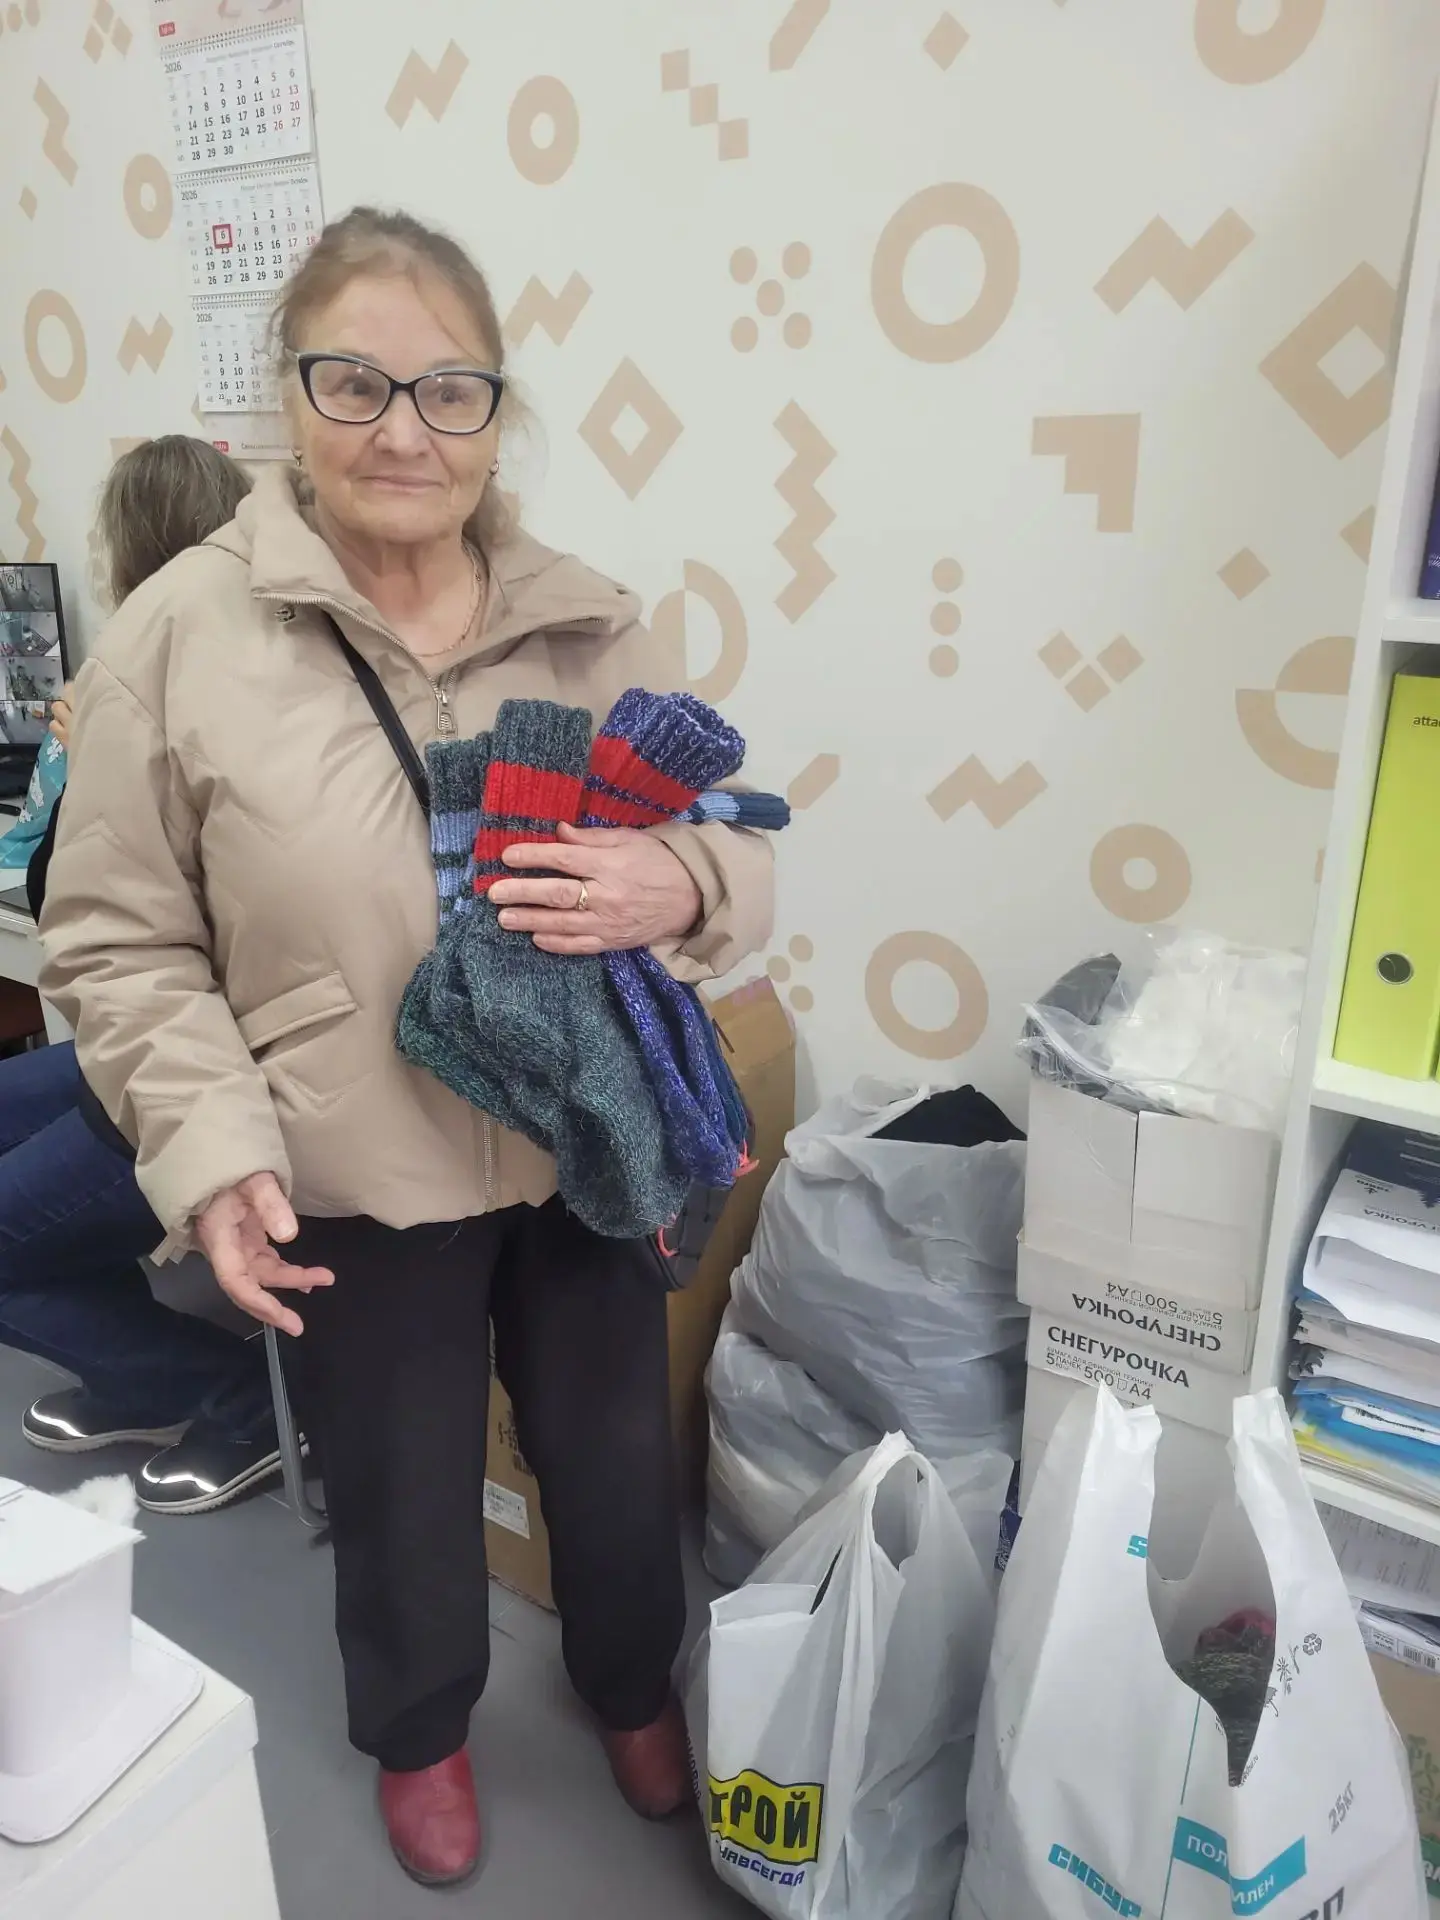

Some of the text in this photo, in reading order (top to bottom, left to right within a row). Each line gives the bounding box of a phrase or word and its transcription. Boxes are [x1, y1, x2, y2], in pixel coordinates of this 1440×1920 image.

[164, 61, 182, 73] 2026
[219, 83, 225, 92] 2
[236, 79, 242, 89] 3
[254, 75, 260, 85] 4
[271, 72, 277, 82] 5
[188, 84, 299, 115] 7 8 9 10 11 12 13
[189, 120, 198, 130] 14
[204, 117, 214, 127] 15
[221, 113, 231, 124] 16
[238, 110, 247, 121] 17
[255, 107, 265, 118] 18
[273, 104, 282, 115] 19
[290, 100, 300, 111] 20
[190, 116, 301, 145] 21 22 23 24 25 26 27
[192, 150, 201, 160] 28
[207, 147, 216, 157] 29
[223, 145, 234, 155] 30
[181, 190, 197, 200] 2026
[269, 208, 275, 218] 2
[287, 206, 292, 216] 3
[305, 204, 310, 215] 4
[205, 232, 210, 241] 5
[220, 230, 226, 240] 6
[237, 228, 242, 238] 7
[254, 226, 259, 236] 8
[271, 224, 276, 234] 9
[287, 222, 297, 232] 10
[205, 246, 213, 256] 12
[237, 243, 247, 253] 14
[254, 241, 264, 251] 15
[271, 239, 281, 249] 16
[288, 237, 298, 248] 17
[207, 260, 215, 270] 19
[222, 259, 232, 269] 20
[239, 258, 248, 267] 21
[255, 256, 265, 266] 22
[272, 254, 282, 264] 23
[208, 275, 217, 285] 26
[223, 273, 233, 283] 27
[240, 271, 250, 282] 28
[257, 270, 267, 280] 29
[273, 269, 284, 279] 30
[197, 313, 213, 322] 2026
[218, 353, 224, 362] 2
[234, 352, 240, 362] 3
[219, 367, 225, 376] 9
[233, 366, 243, 376] 10
[220, 381, 229, 390] 16
[235, 380, 245, 390] 17
[237, 395, 246, 403] 24
[1413, 715, 1440, 727] atta
[1145, 1293, 1178, 1313] 500
[1072, 1293, 1221, 1352] СНЕГУРОЧКА
[1212, 1312, 1223, 1325] 5
[1047, 1326, 1189, 1388] СНЕГУРОЧКА
[1046, 1352, 1055, 1365] 5
[1055, 1355, 1081, 1371] ПАЧЕК
[1084, 1365, 1114, 1387] 500
[1047, 1843, 1142, 1918] СИБУР
